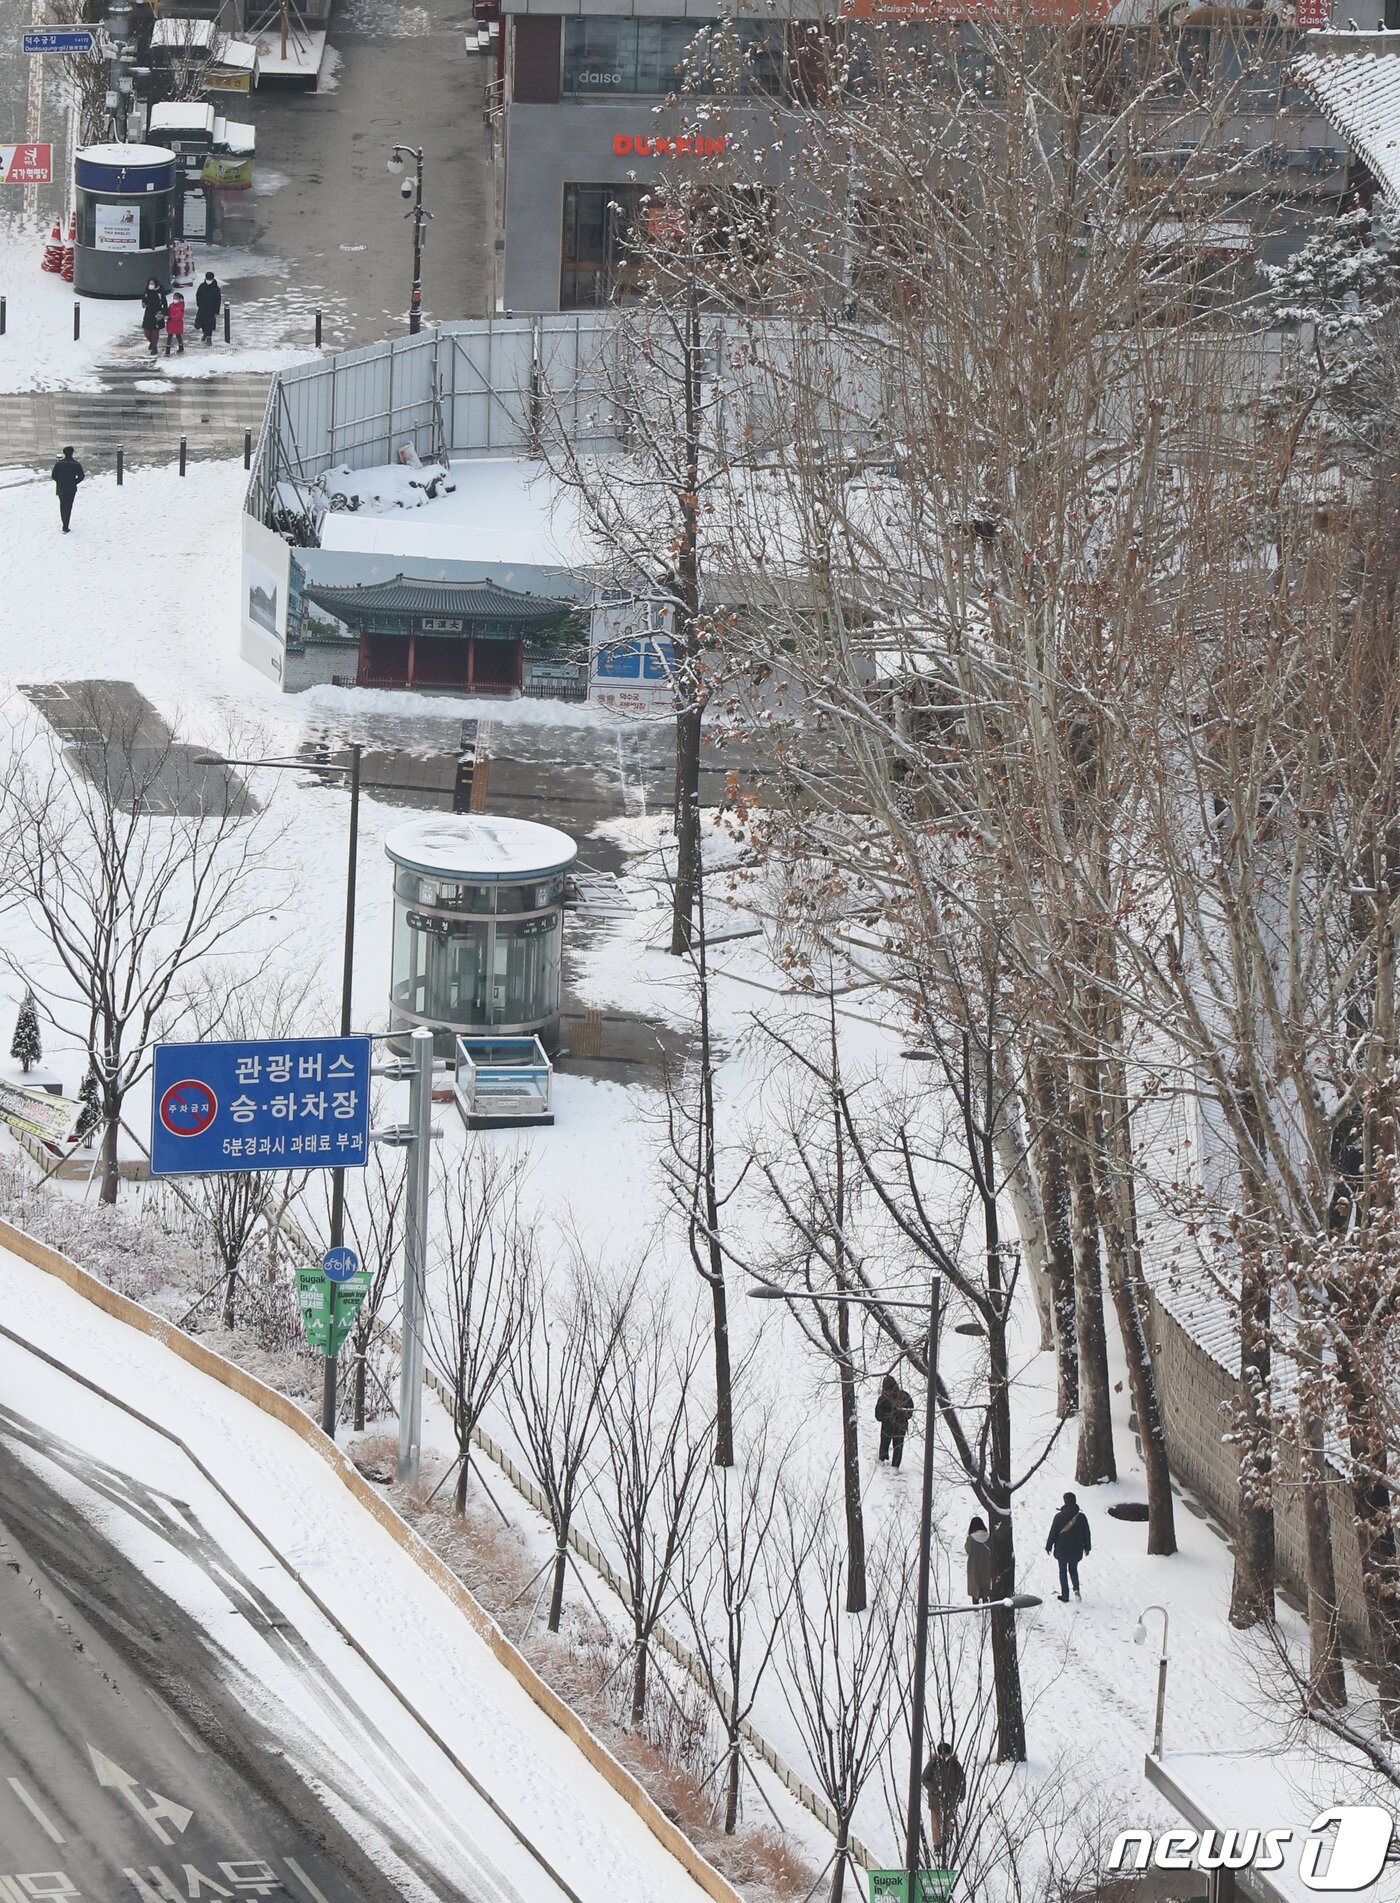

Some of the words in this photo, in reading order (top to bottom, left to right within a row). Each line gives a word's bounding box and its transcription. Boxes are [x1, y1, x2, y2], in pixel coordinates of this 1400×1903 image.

[25, 36, 56, 44] 덕수궁길
[579, 70, 621, 83] daiso
[12, 168, 48, 180] 국가혁명당
[235, 1053, 355, 1085] 관광버스
[168, 1103, 210, 1114] 주차금지
[222, 1135, 285, 1157] 5분경과시
[290, 1134, 332, 1154] 과태료
[336, 1132, 363, 1152] 부과
[300, 1275, 326, 1284] Gugak
[873, 1875, 903, 1885] Gugak
